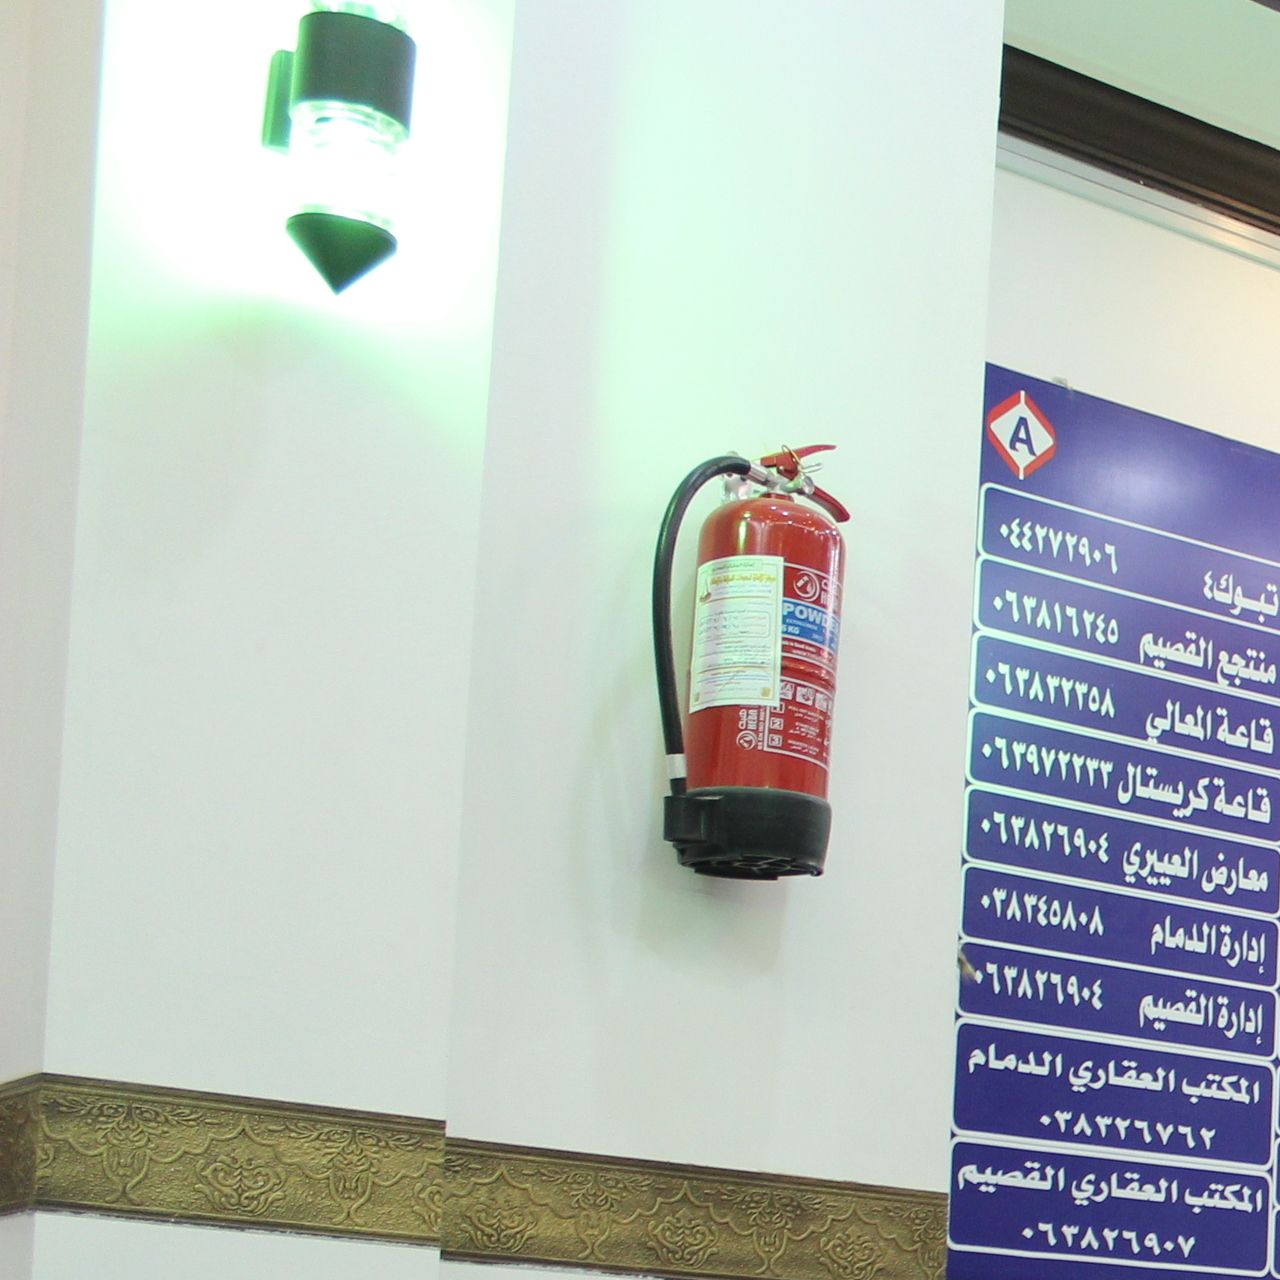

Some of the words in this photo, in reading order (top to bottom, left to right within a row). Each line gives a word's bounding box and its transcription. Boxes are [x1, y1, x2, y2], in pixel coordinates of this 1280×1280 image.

[1000, 518, 1118, 574] ٠٤٤٢٧٢٩٠٦
[993, 590, 1118, 643] ٠٦٣٨١٦٢٤٥
[986, 662, 1115, 718] ٠٦٣٨٣٢٣٥٨
[982, 736, 1113, 789] ٠٦٣٩٧٢٢٣٣
[981, 811, 1109, 863] ٠٦٣٨٢٦٩٠٤
[981, 888, 1104, 935] ٠٣٨٣٤٥٨٠٨
[974, 962, 1102, 1010] ٠٦٣٨٢٦٩٠٤
[1040, 1109, 1216, 1150] ٠٣٨٣٢٦٧٦٢
[1022, 1222, 1196, 1258] ٠٦٣٨٢٦٩٠٧
